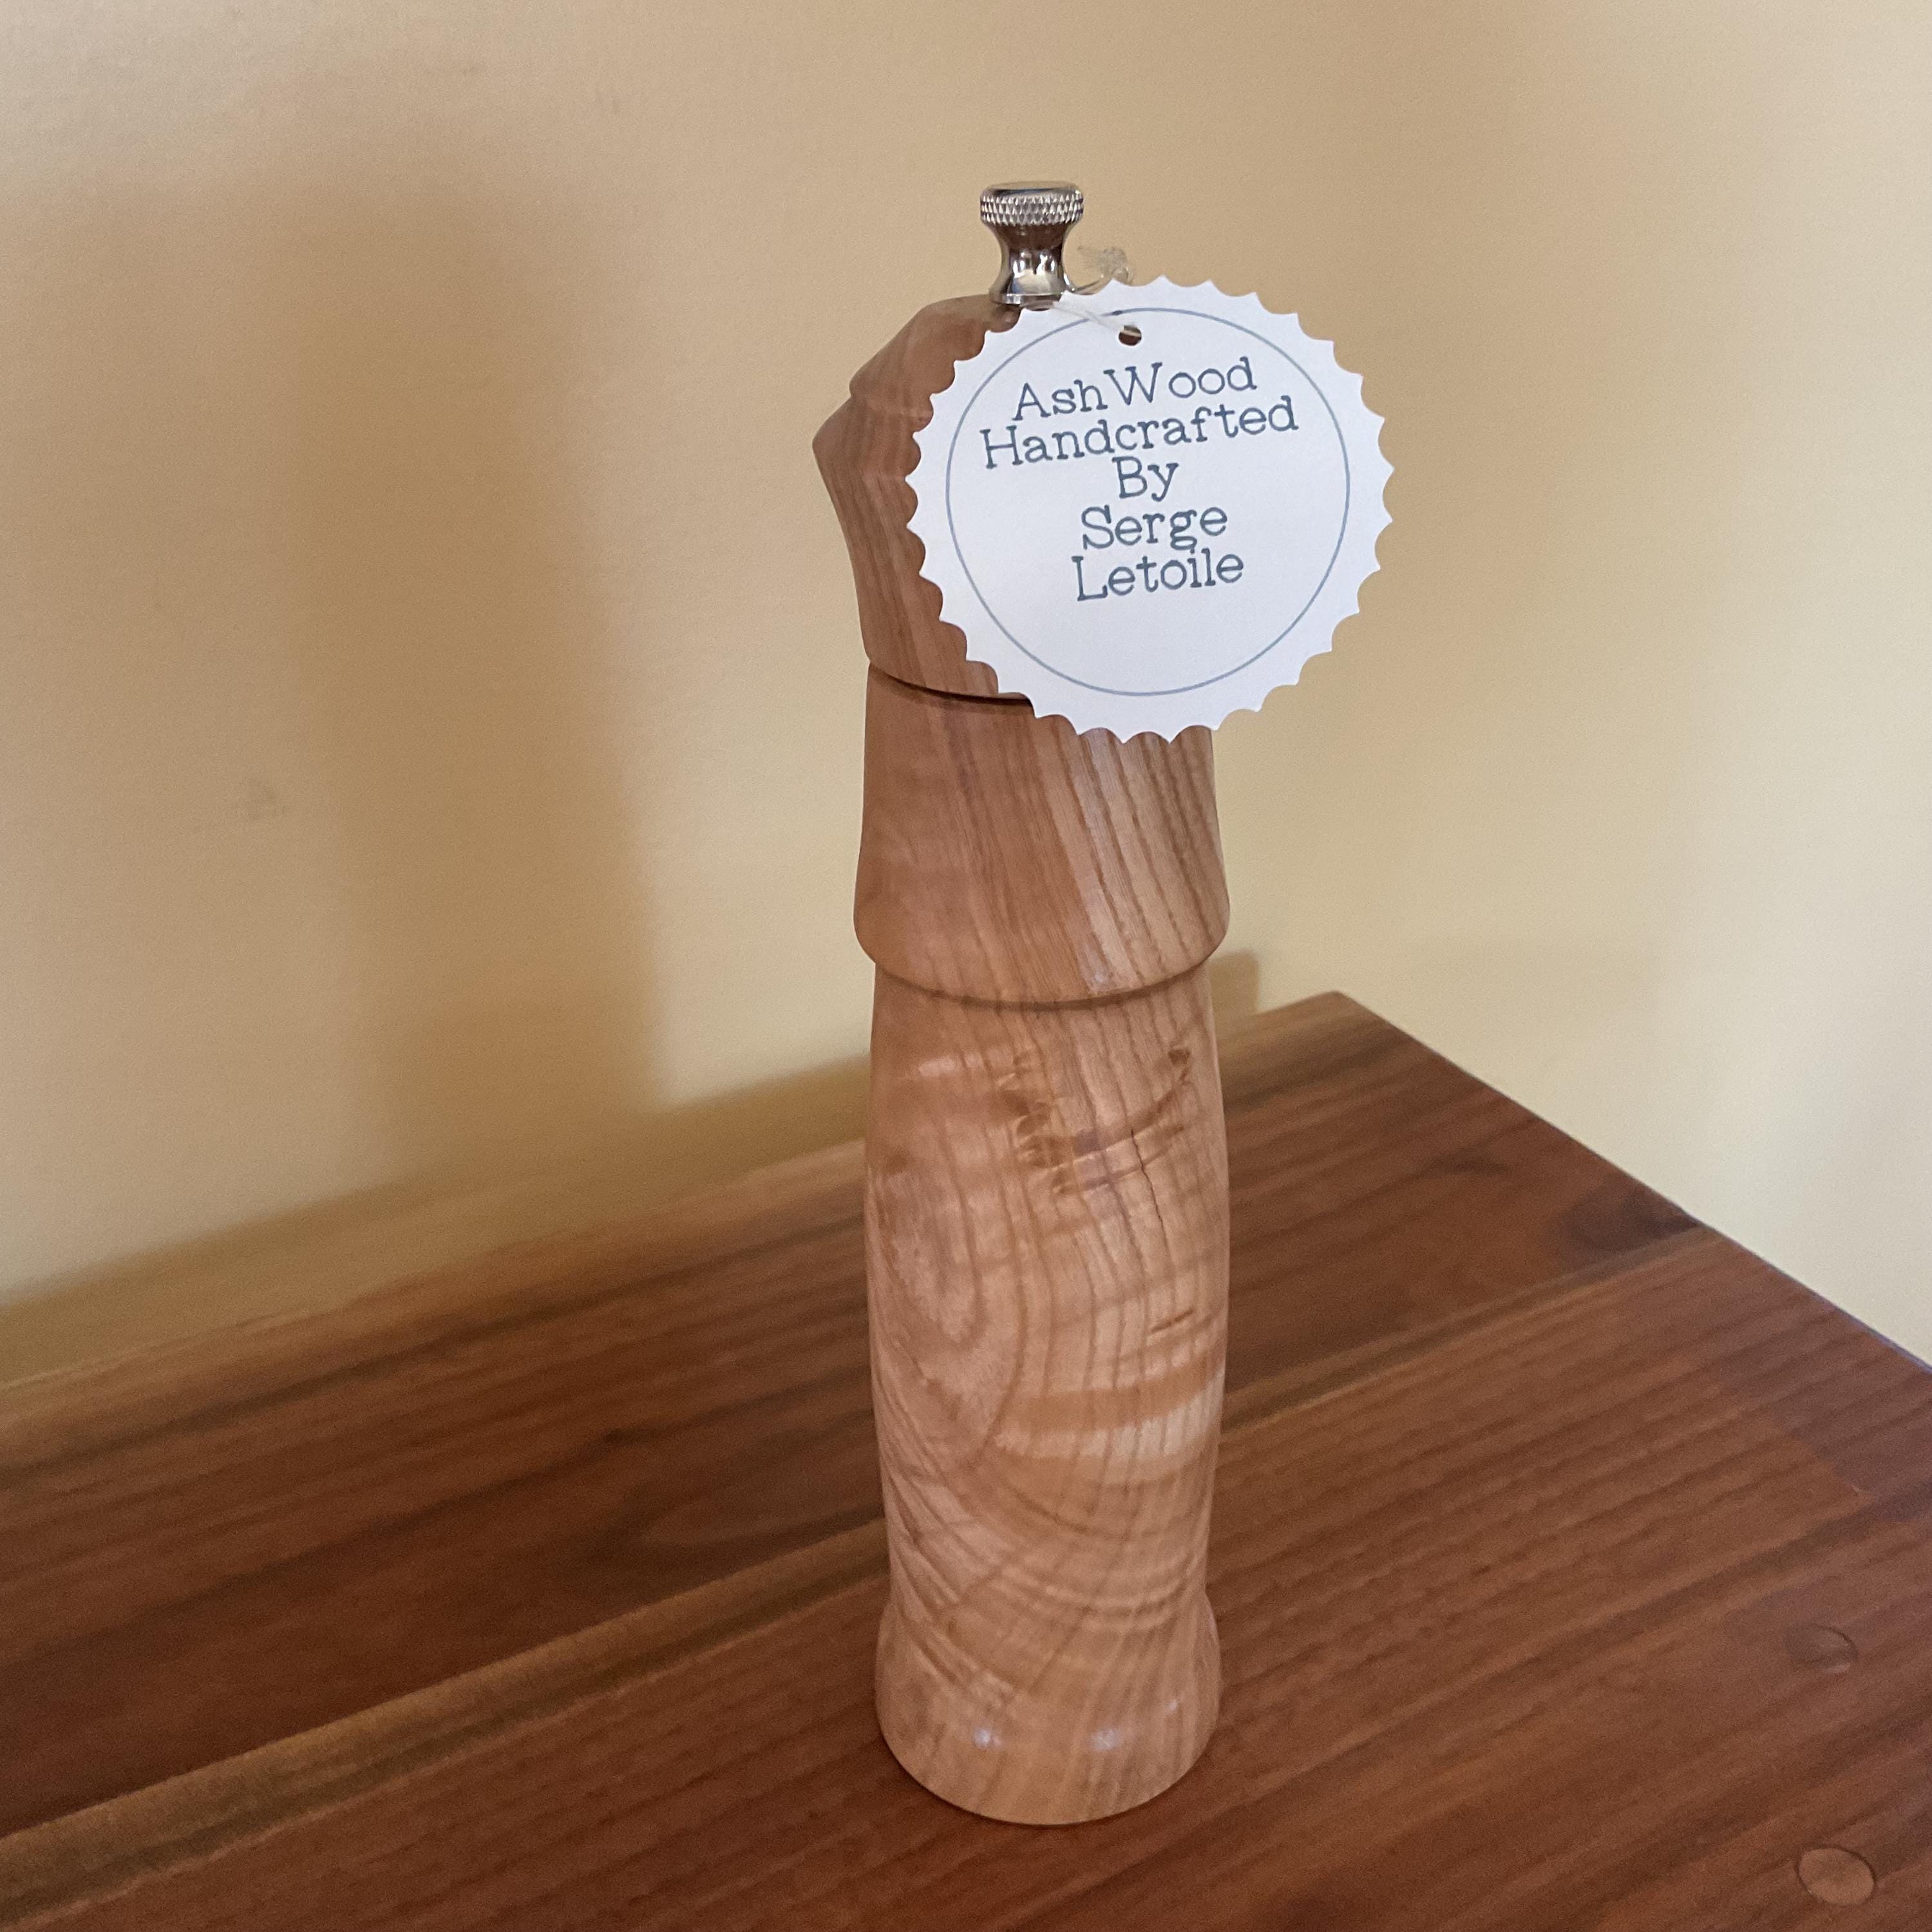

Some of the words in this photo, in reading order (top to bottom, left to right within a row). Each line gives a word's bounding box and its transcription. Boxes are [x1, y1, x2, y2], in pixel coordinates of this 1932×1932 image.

[979, 395, 1300, 470] Handcrafted
[1111, 455, 1180, 503] By
[1081, 504, 1228, 552] Serge
[1070, 547, 1244, 602] Letoile
